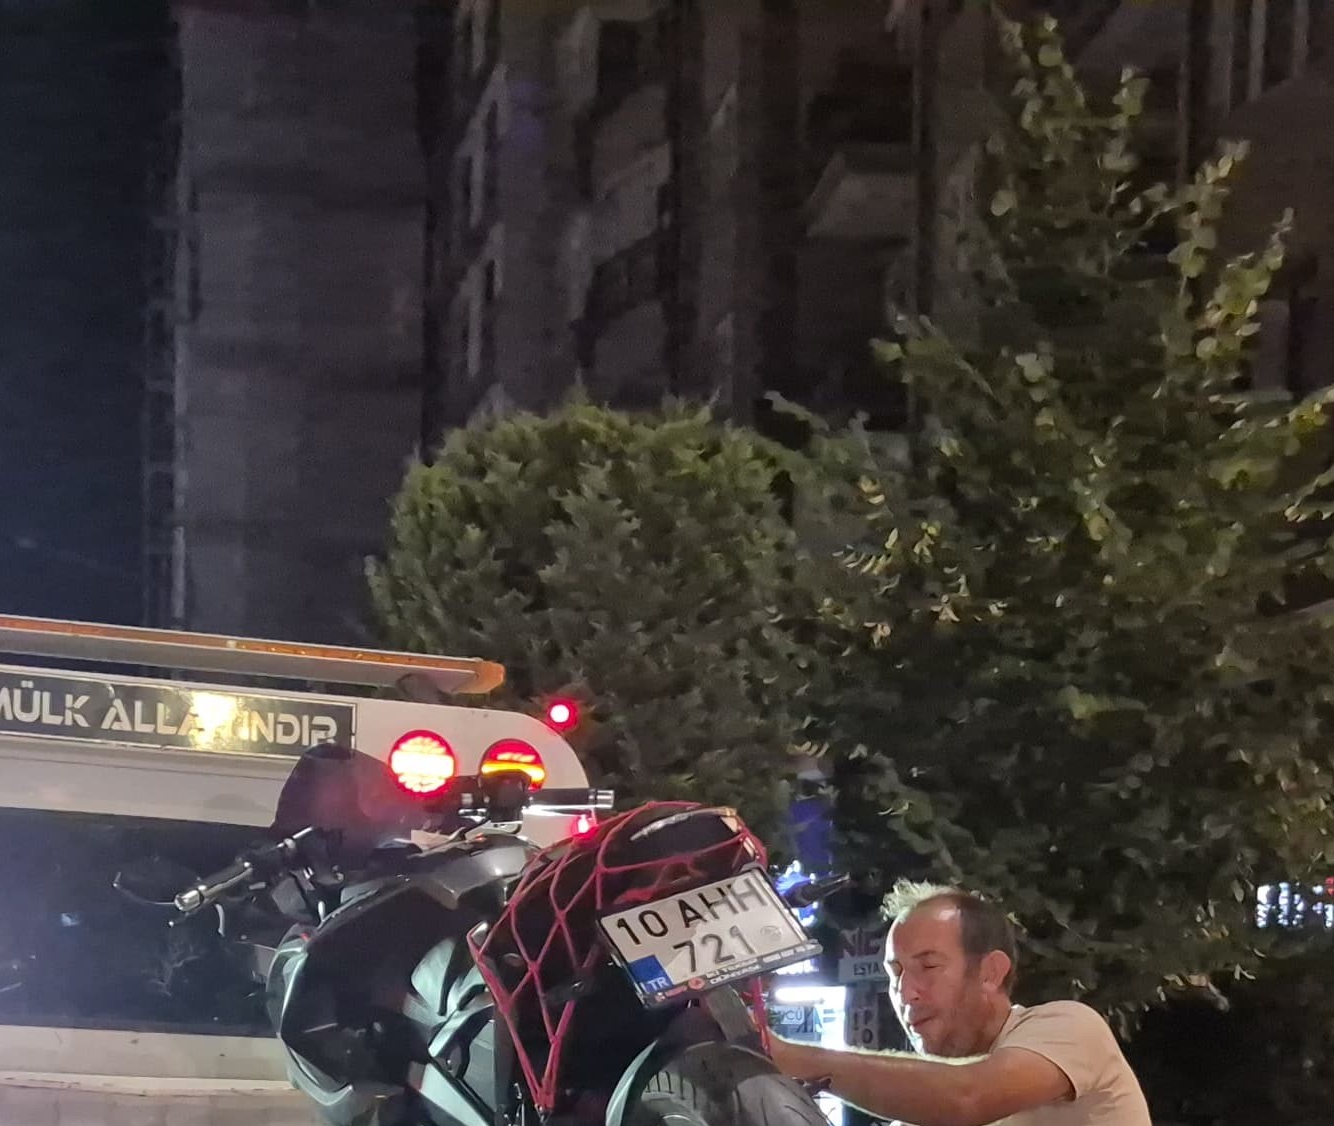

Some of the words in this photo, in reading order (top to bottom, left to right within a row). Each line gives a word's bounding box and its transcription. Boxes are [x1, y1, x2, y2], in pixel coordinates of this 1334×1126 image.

[101, 696, 338, 749] ALLAINDIR
[615, 909, 669, 945] 10
[677, 877, 768, 929] AHH
[673, 924, 757, 973] 721
[647, 976, 669, 991] TR
